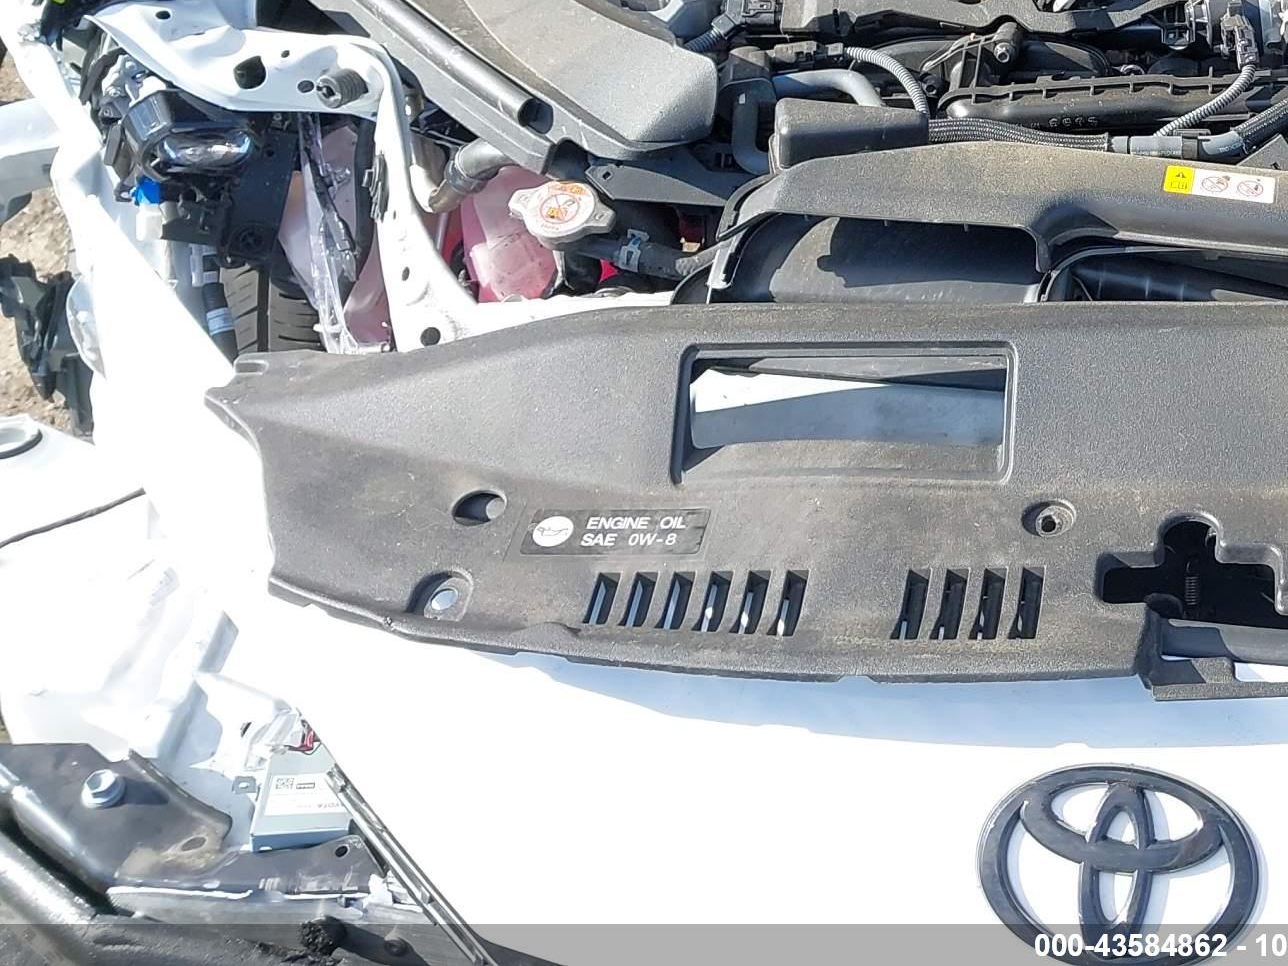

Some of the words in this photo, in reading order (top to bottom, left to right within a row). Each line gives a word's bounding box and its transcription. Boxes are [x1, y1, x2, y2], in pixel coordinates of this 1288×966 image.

[587, 516, 650, 529] ENGINE
[660, 516, 686, 529] OIL
[580, 533, 617, 546] SAE
[628, 533, 677, 546] 0W-8
